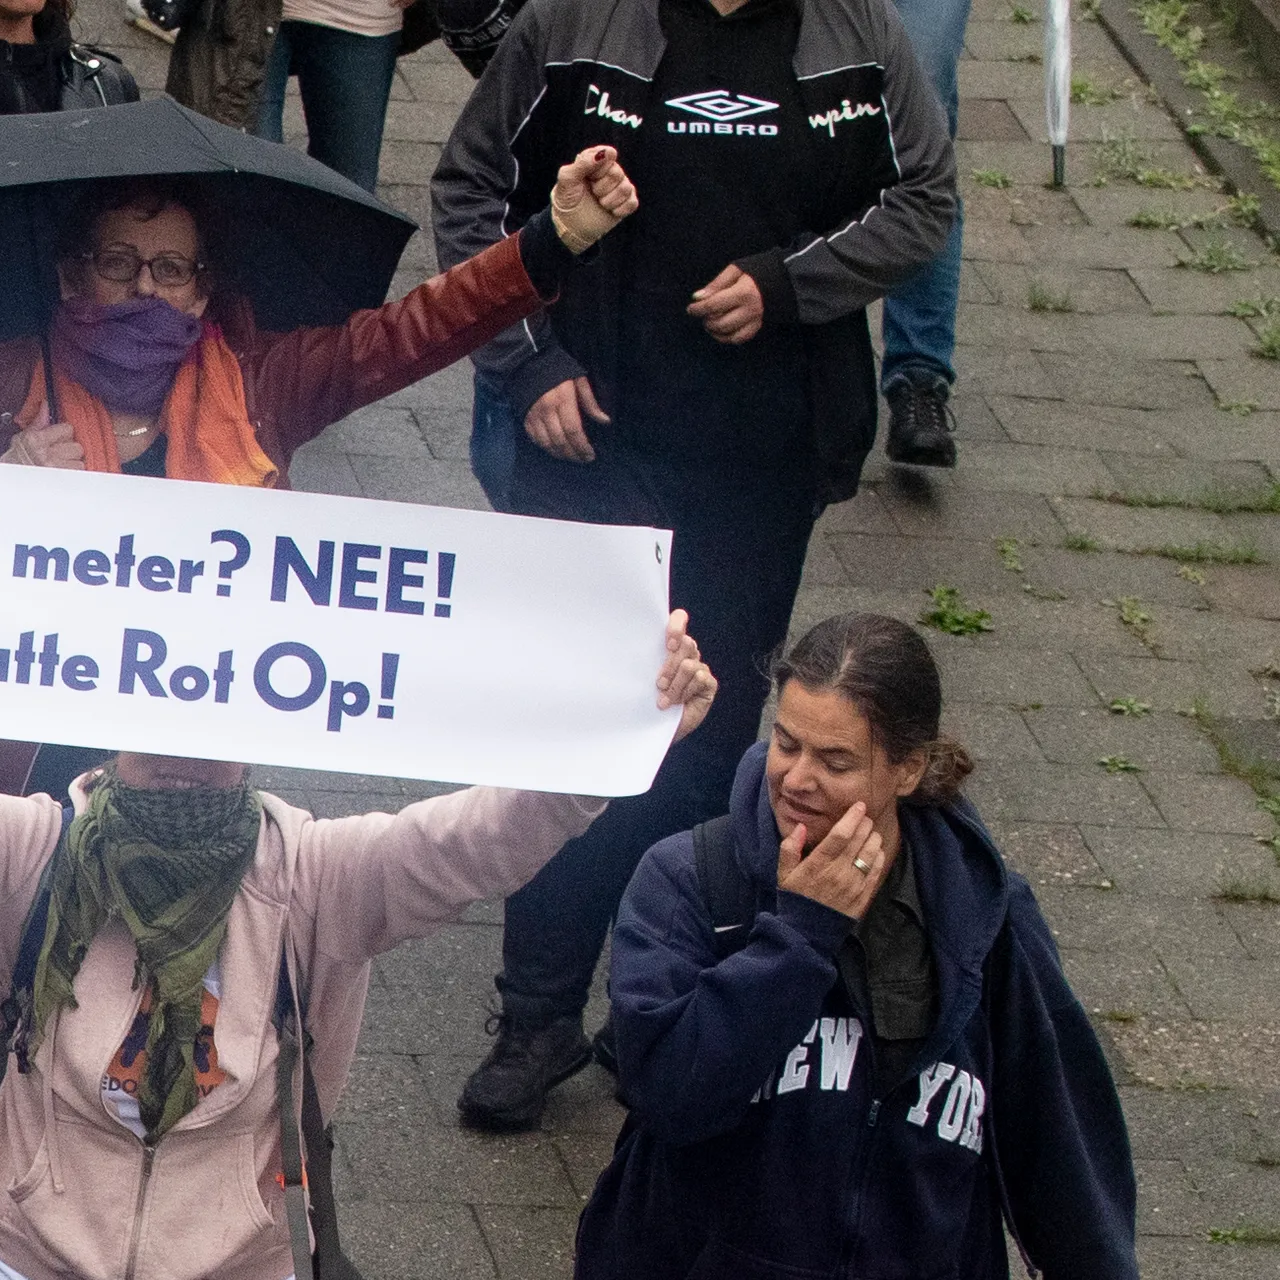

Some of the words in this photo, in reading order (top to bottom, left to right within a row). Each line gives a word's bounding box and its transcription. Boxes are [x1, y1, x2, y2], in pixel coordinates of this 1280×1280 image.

[667, 122, 778, 135] UMBRO
[12, 529, 251, 597] meter?
[270, 535, 456, 618] NEE!
[118, 628, 234, 704] Rot
[252, 641, 400, 732] Op!
[750, 1017, 863, 1102] EW
